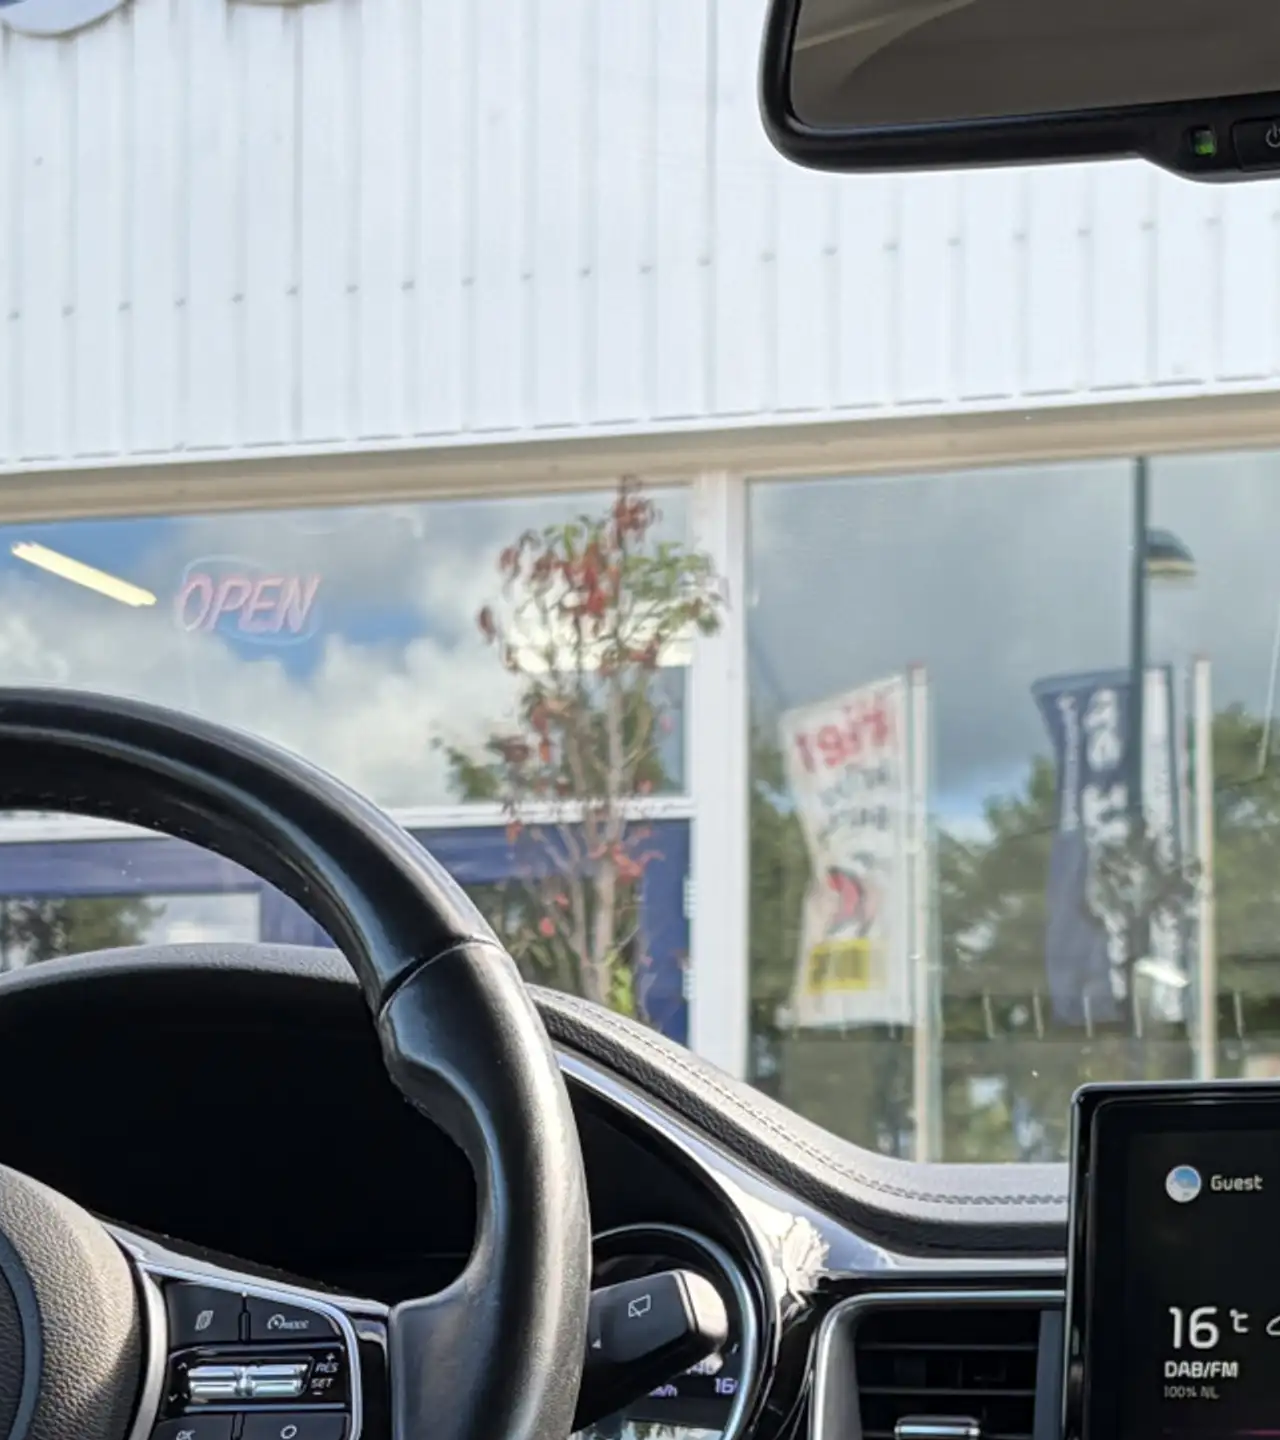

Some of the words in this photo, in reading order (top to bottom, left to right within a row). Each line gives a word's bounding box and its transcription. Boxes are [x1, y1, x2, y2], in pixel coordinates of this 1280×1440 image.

[176, 573, 322, 634] OPEN
[1210, 1174, 1263, 1191] Guest
[1169, 1305, 1220, 1349] 16
[1163, 1360, 1240, 1378] DAB/FM
[311, 1377, 334, 1389] SET
[1163, 1384, 1198, 1398] 100%
